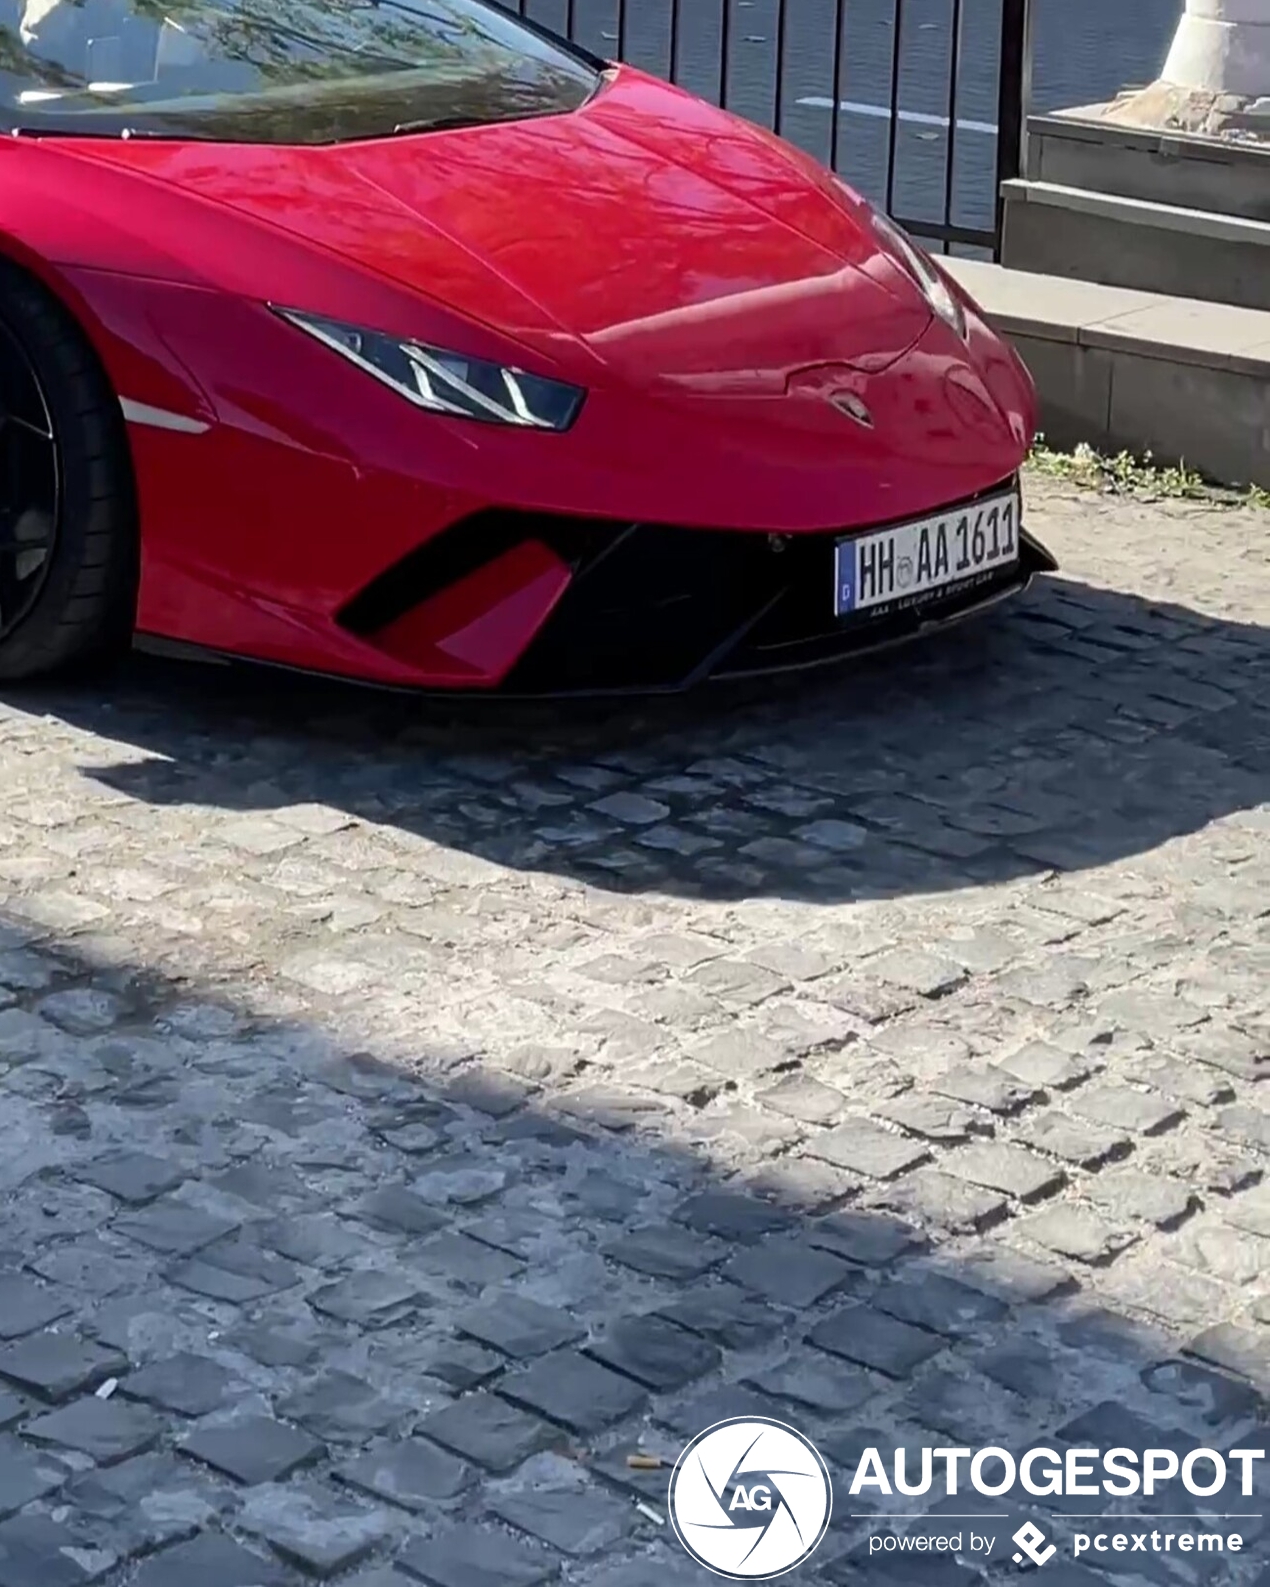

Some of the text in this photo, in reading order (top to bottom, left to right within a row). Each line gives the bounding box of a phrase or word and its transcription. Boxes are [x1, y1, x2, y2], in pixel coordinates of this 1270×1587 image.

[859, 500, 1016, 601] HH AA 1611
